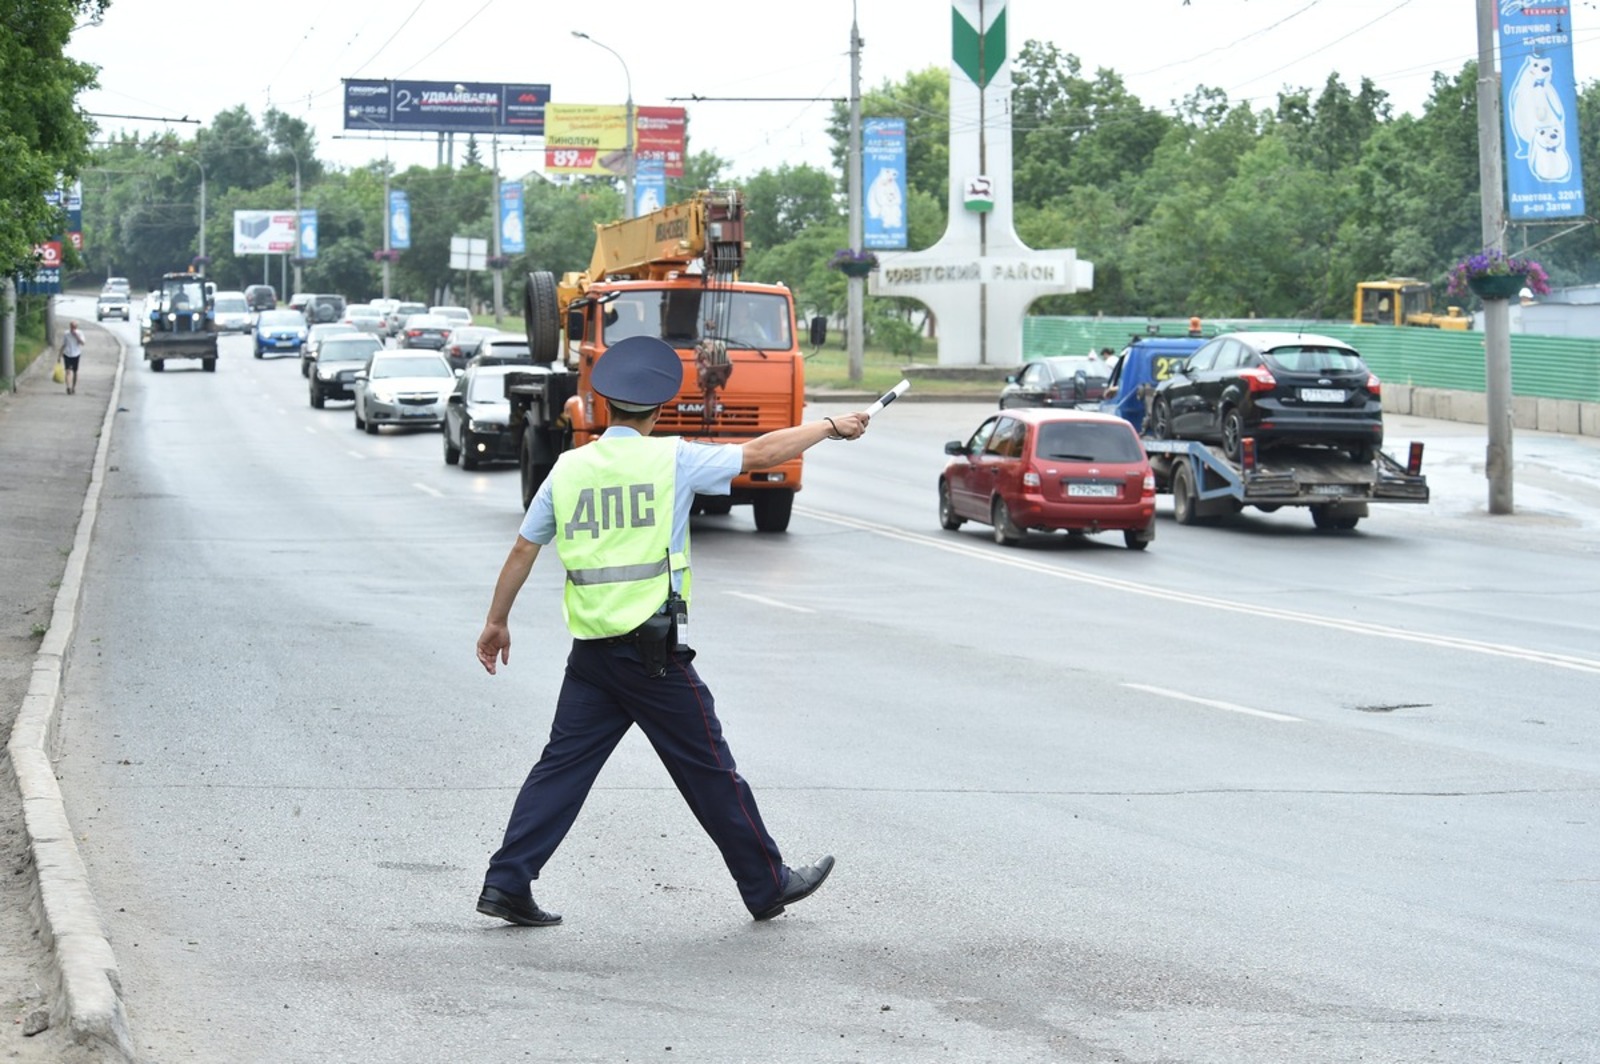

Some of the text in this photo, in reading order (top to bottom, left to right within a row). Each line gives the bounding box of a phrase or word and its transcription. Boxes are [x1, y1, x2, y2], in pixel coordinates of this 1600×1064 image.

[1503, 24, 1551, 34] Отличное
[548, 136, 599, 145] ЛИНОЛЕУМ
[553, 150, 580, 167] 89
[1545, 202, 1571, 211] Затон
[885, 262, 1055, 284] СОВЕТСКИЙ РАЙОН
[565, 483, 656, 540] ДПС
